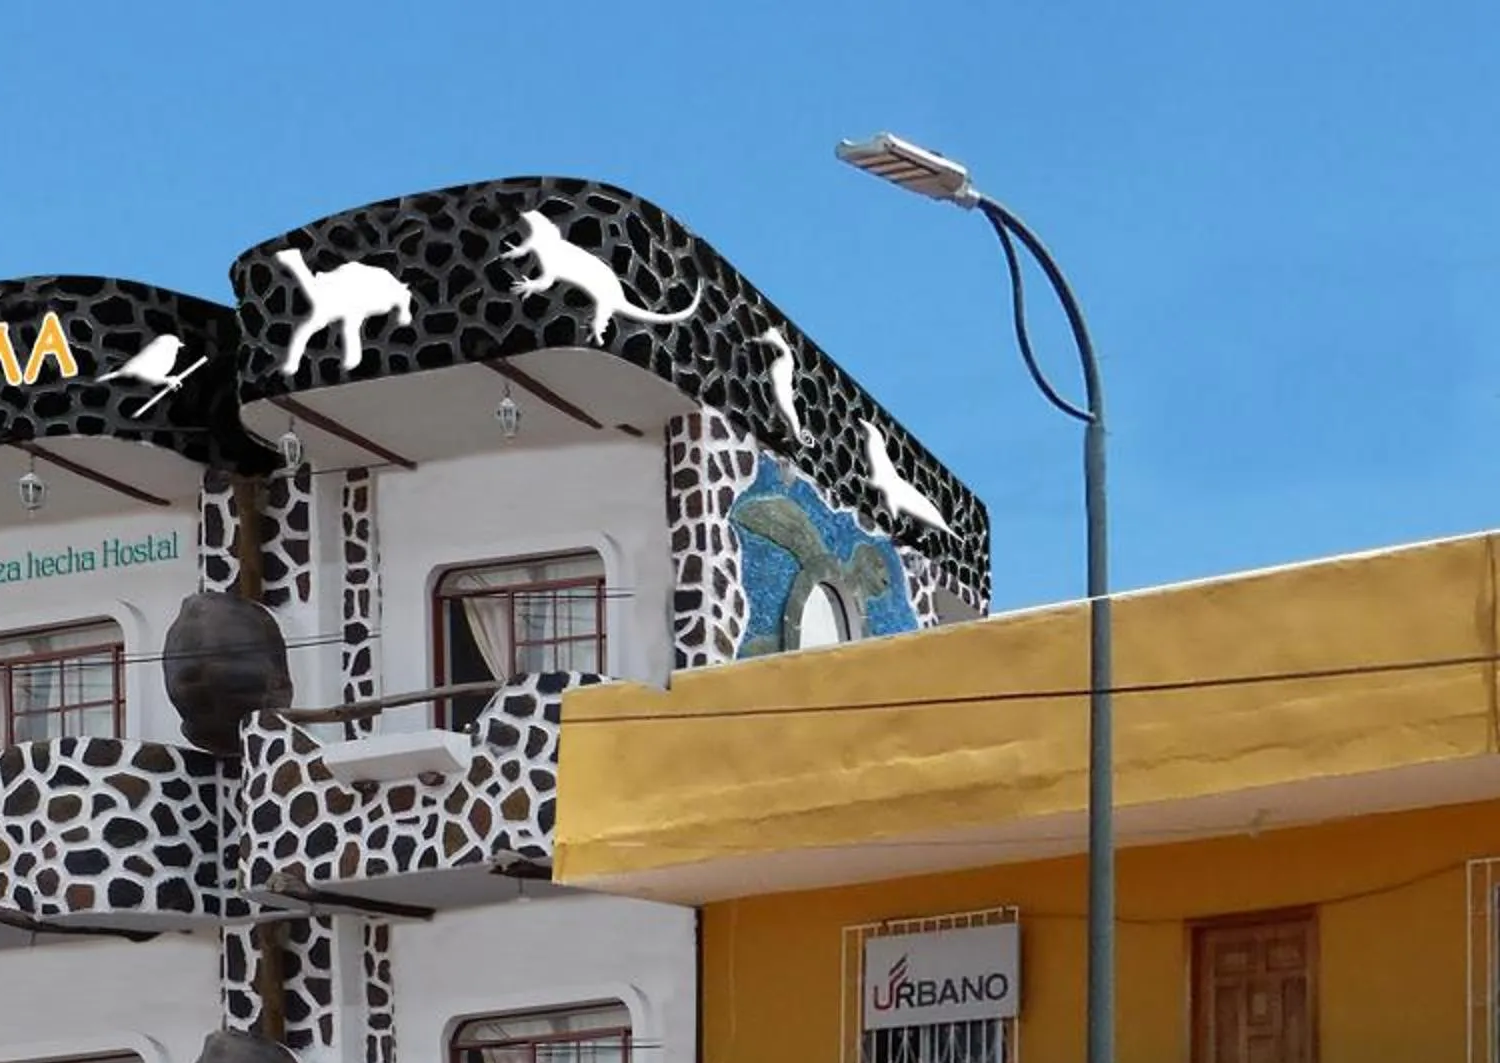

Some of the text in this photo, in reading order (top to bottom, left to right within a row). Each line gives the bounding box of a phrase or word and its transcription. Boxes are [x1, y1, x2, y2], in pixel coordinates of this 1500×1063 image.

[27, 546, 96, 579] hecha
[102, 531, 179, 568] Hostal
[873, 956, 1009, 1011] URBANO
